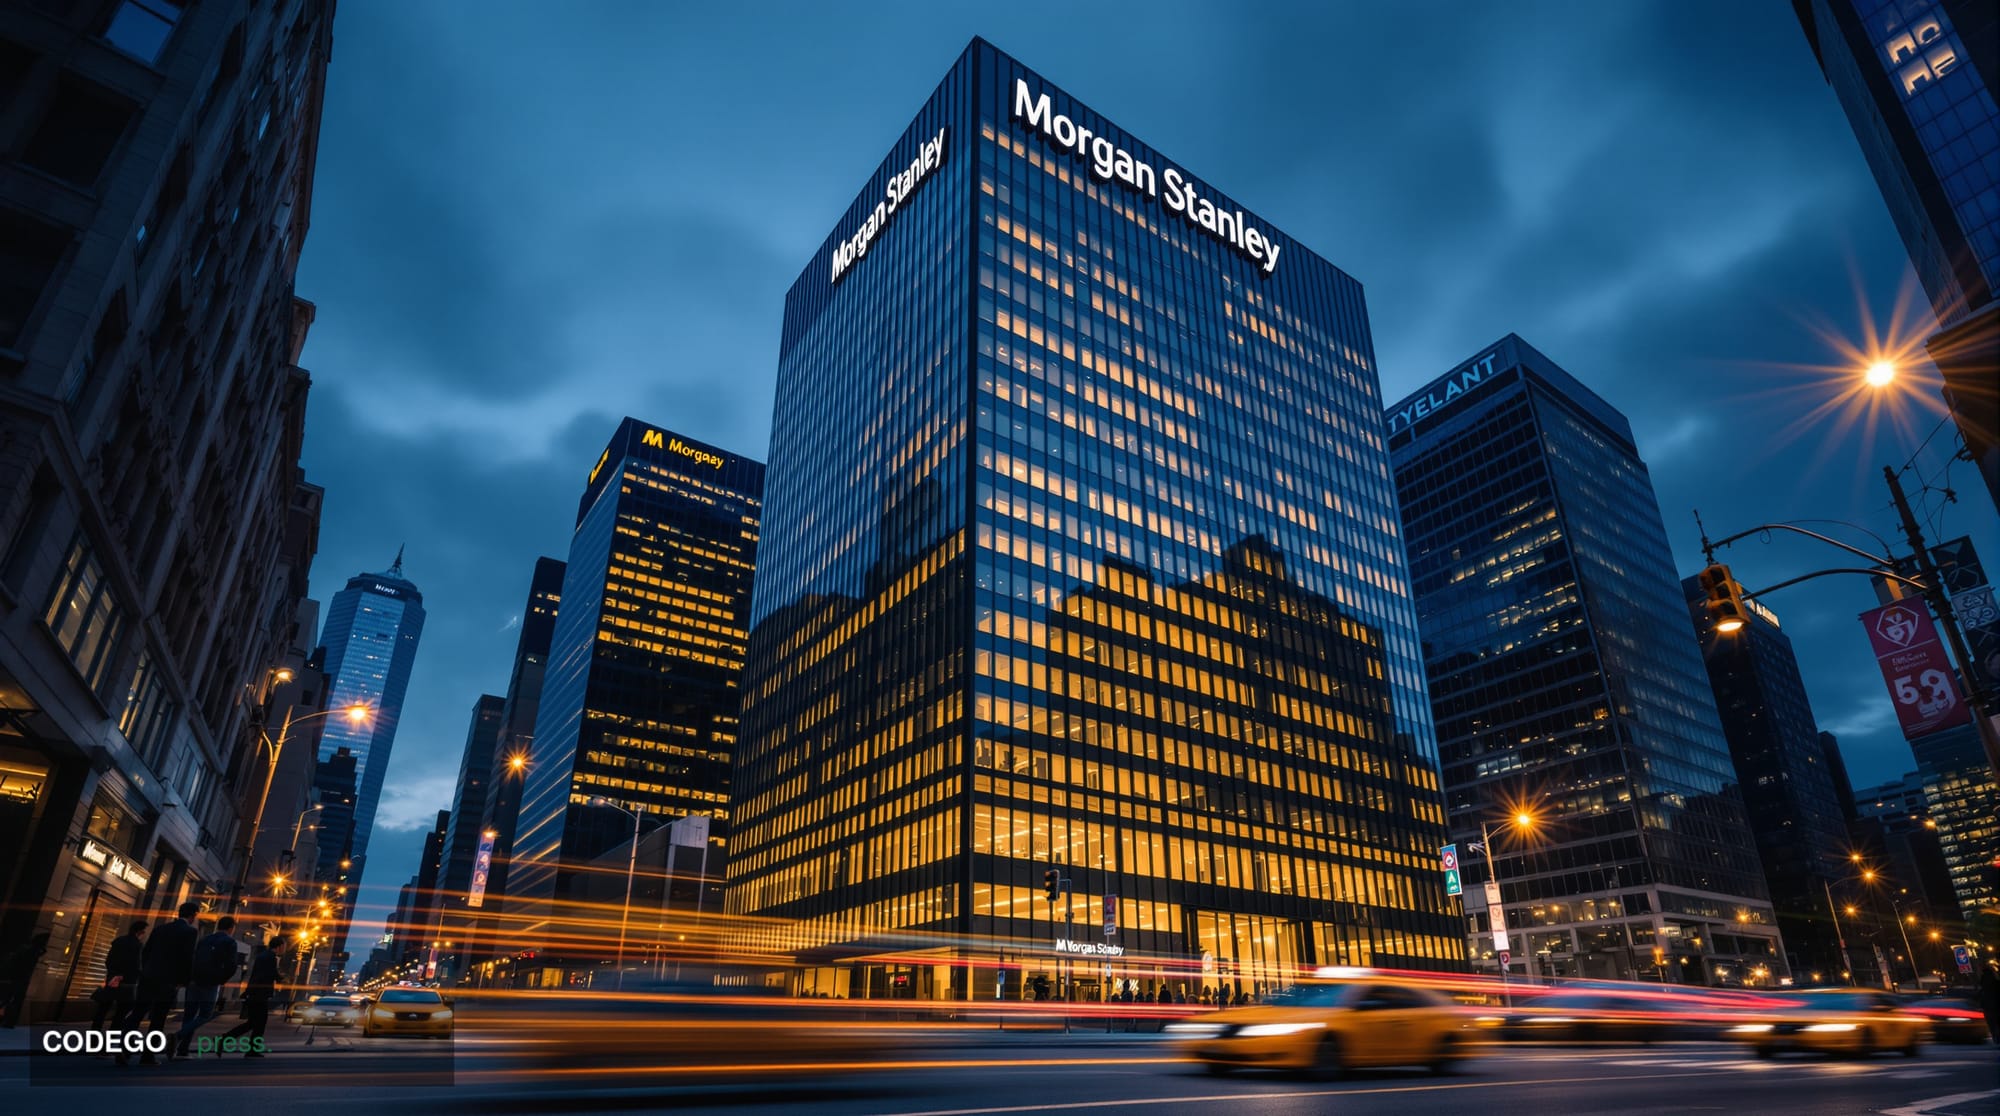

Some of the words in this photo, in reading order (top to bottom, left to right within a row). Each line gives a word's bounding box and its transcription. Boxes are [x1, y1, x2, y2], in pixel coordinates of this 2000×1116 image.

[831, 201, 886, 283] Morgan
[887, 127, 945, 215] Stanley
[1015, 78, 1155, 197] Morgan
[1163, 168, 1281, 273] Stanley
[1387, 352, 1496, 433] TYELANT
